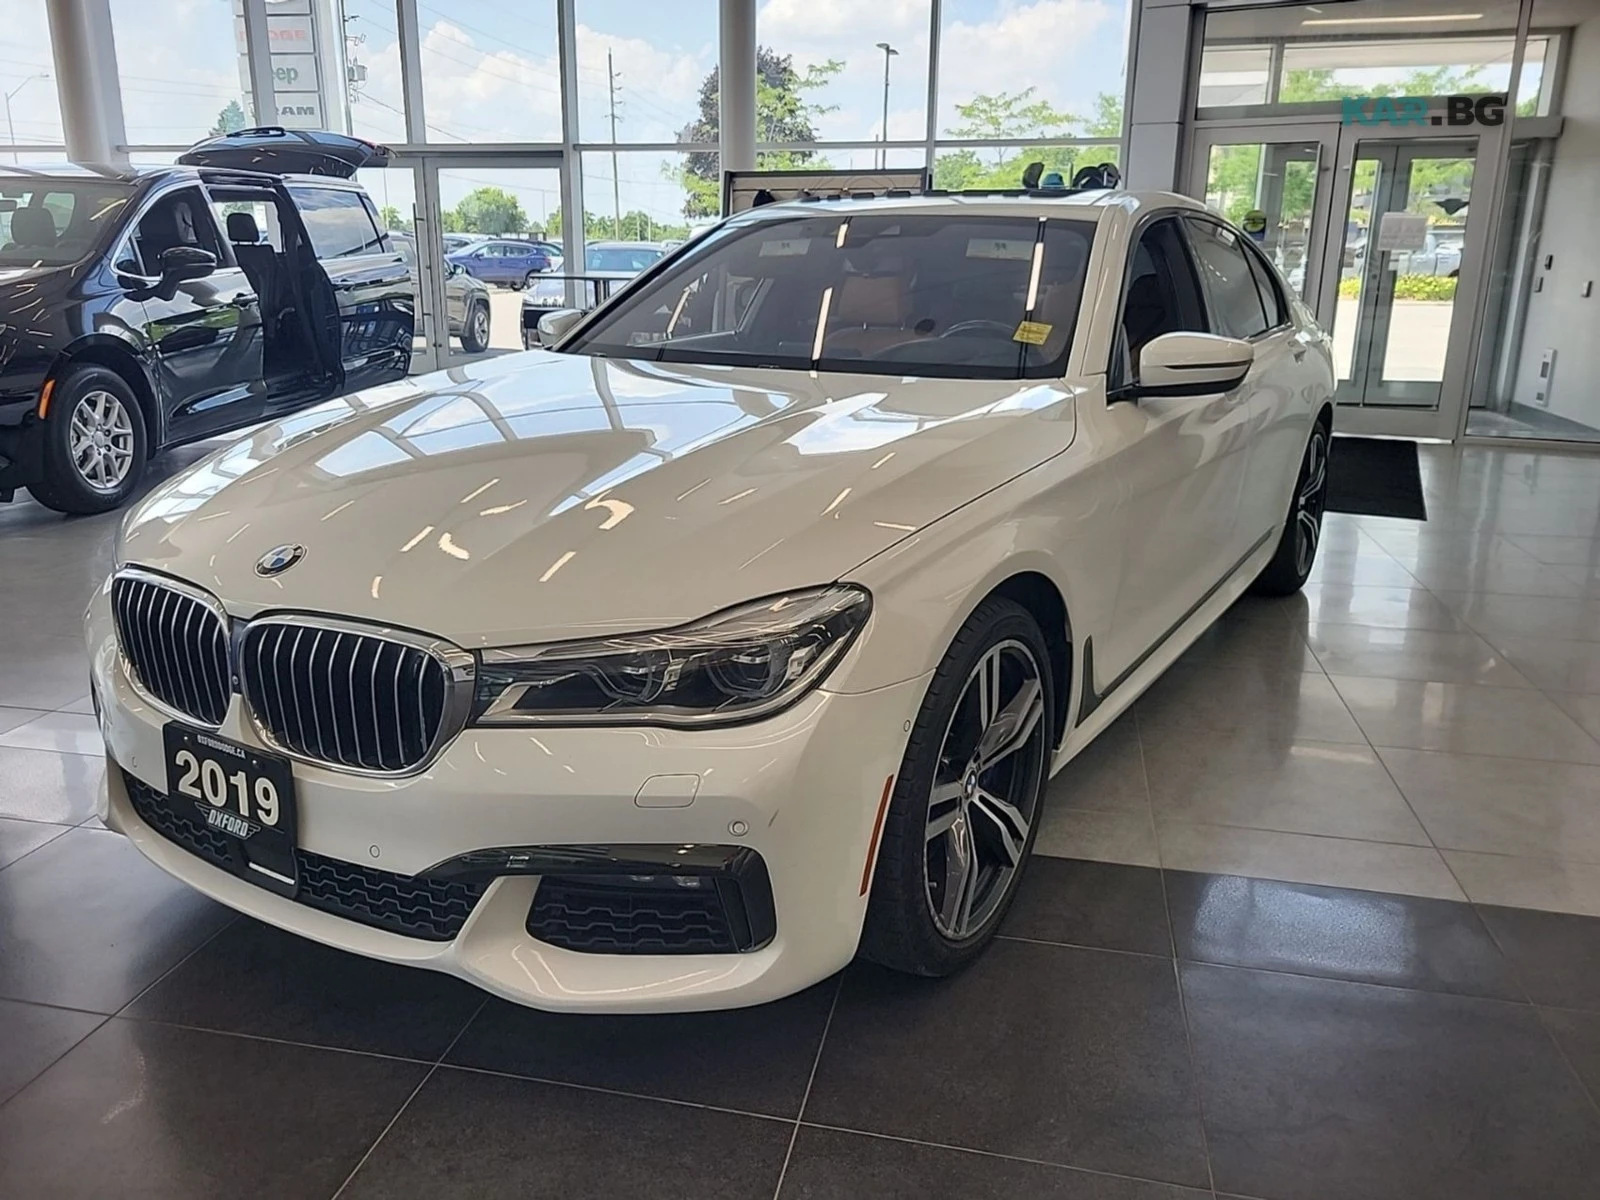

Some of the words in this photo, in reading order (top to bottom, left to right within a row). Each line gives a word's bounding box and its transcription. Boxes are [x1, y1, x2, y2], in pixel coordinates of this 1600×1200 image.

[276, 106, 315, 116] AM
[175, 750, 279, 826] 2019
[208, 809, 249, 837] OXFORD
